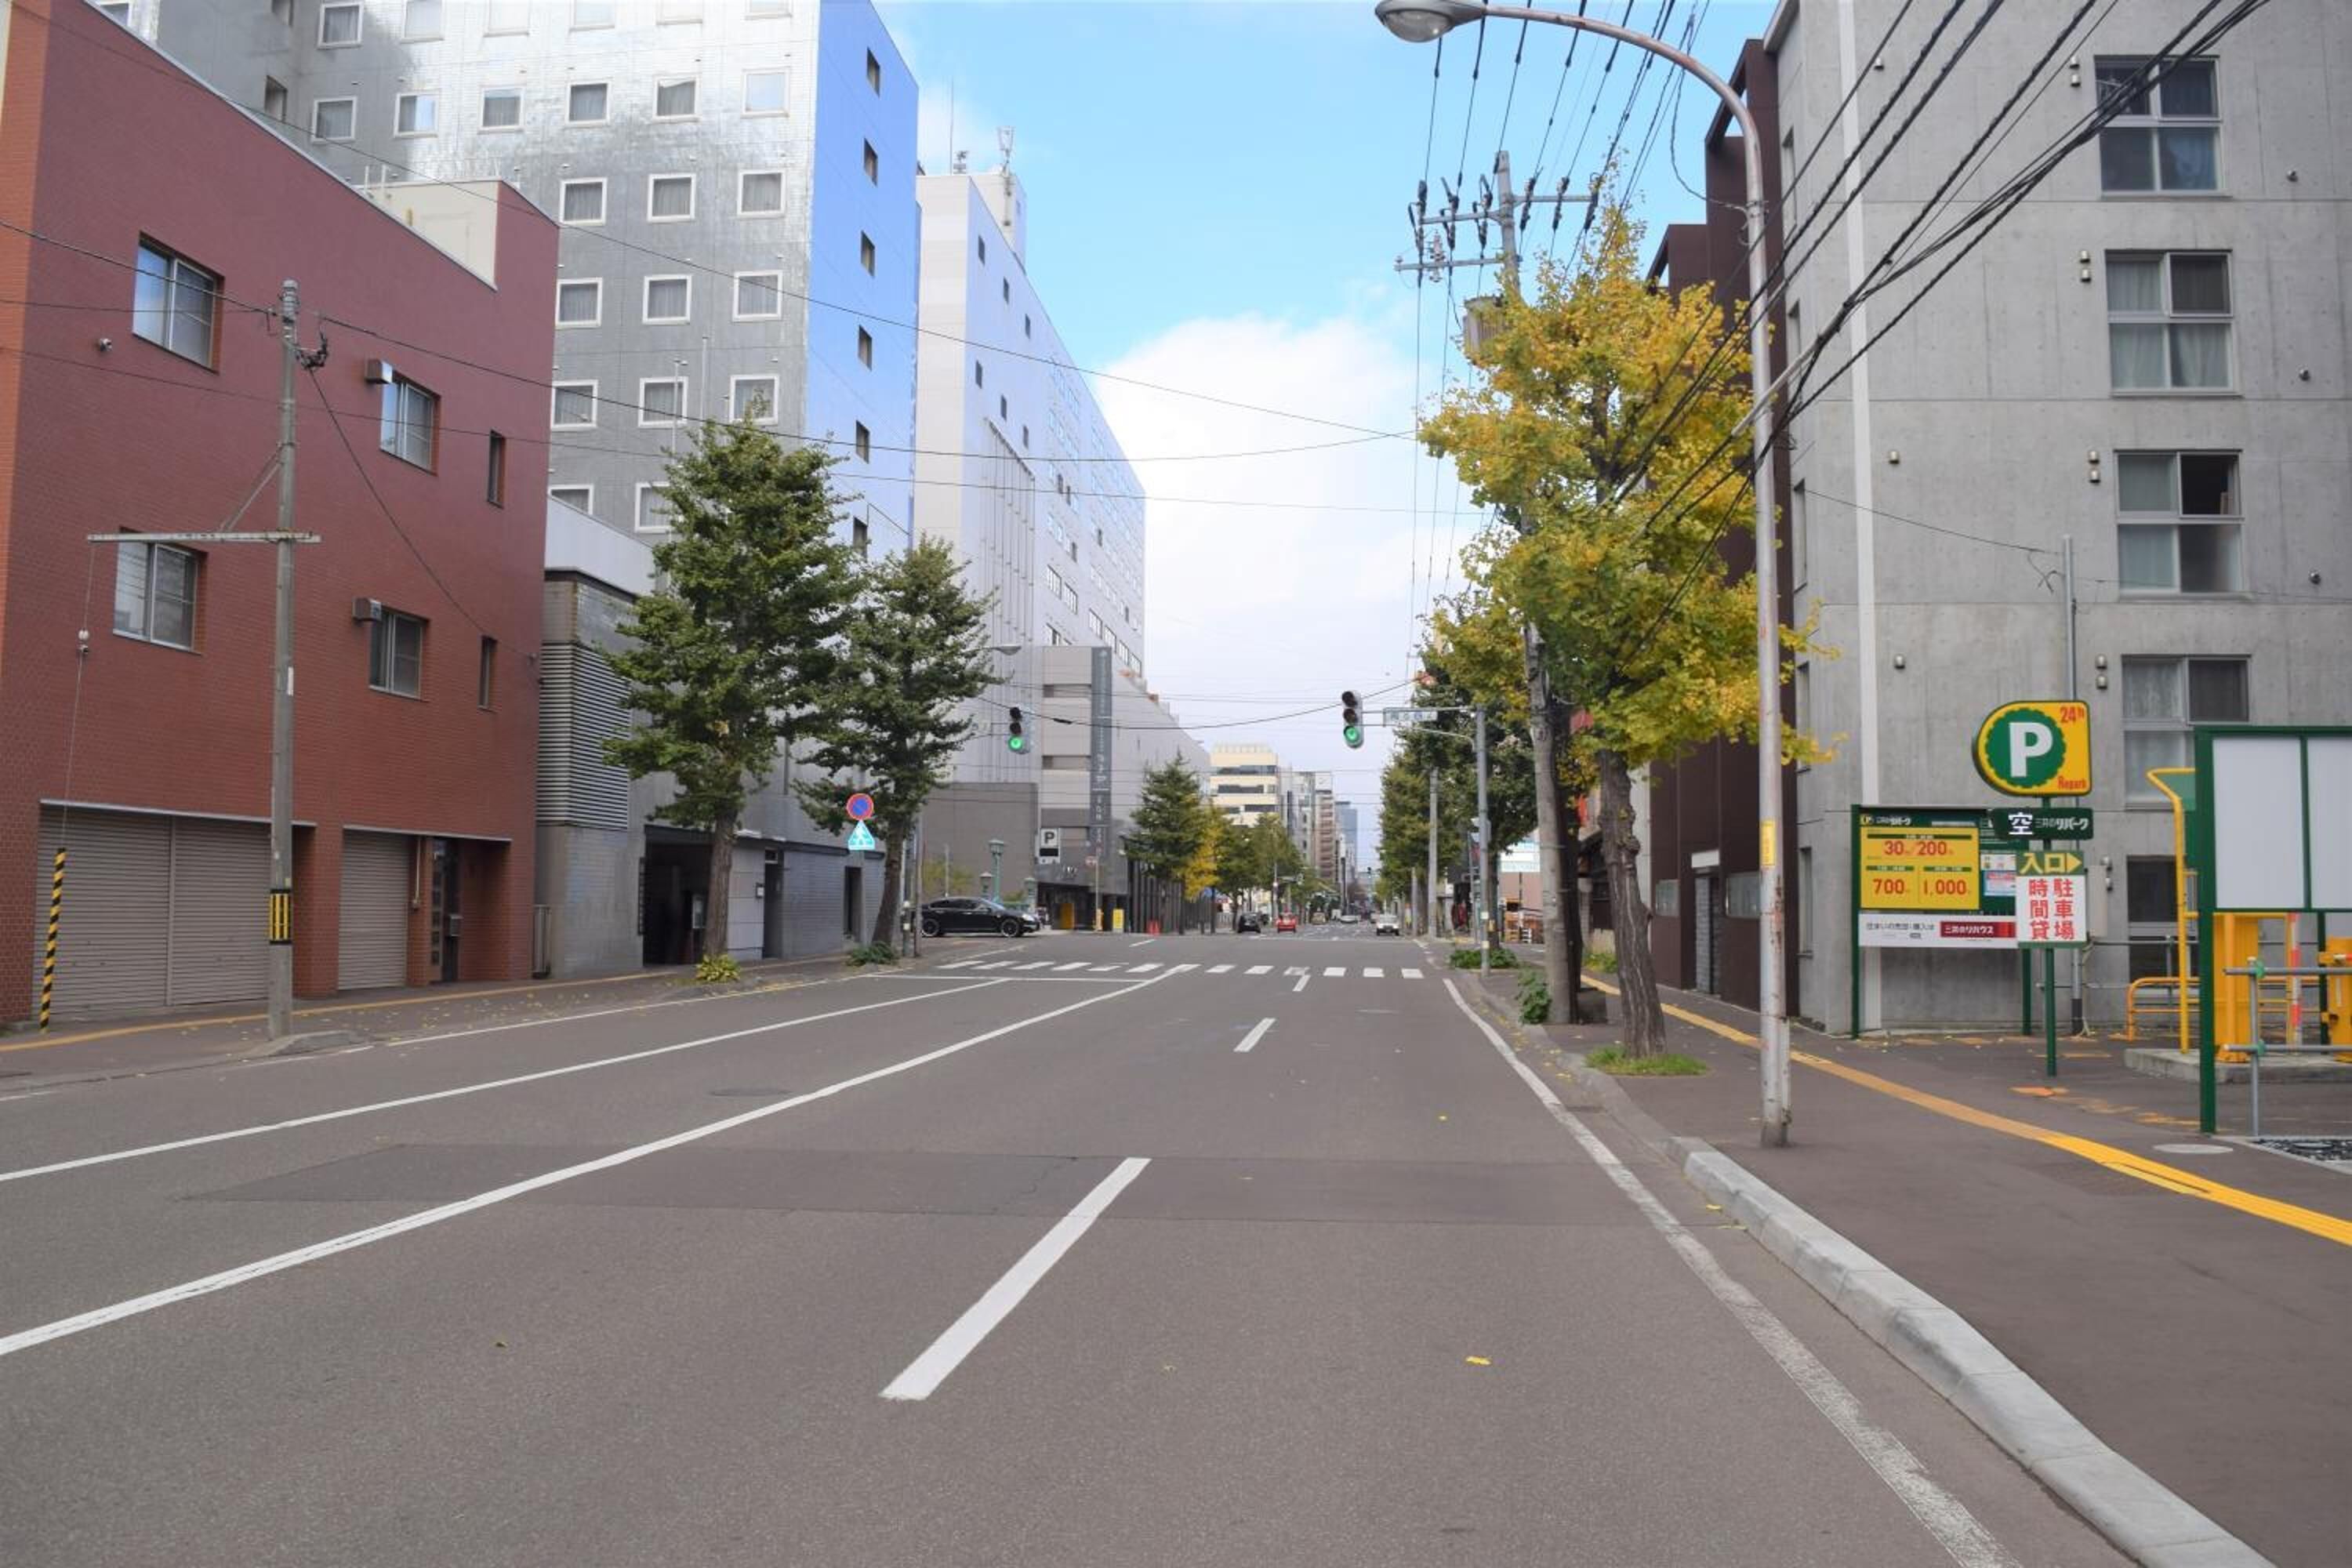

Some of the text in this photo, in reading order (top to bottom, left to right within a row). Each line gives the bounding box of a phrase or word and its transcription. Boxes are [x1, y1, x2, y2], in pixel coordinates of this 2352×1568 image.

[2009, 722, 2053, 778] P
[2009, 812, 2033, 835] 空
[2035, 818, 2089, 830] 三井のリパーク
[1044, 832, 1054, 844] P
[2020, 853, 2066, 873] 入口
[2054, 878, 2074, 939] 駐車場
